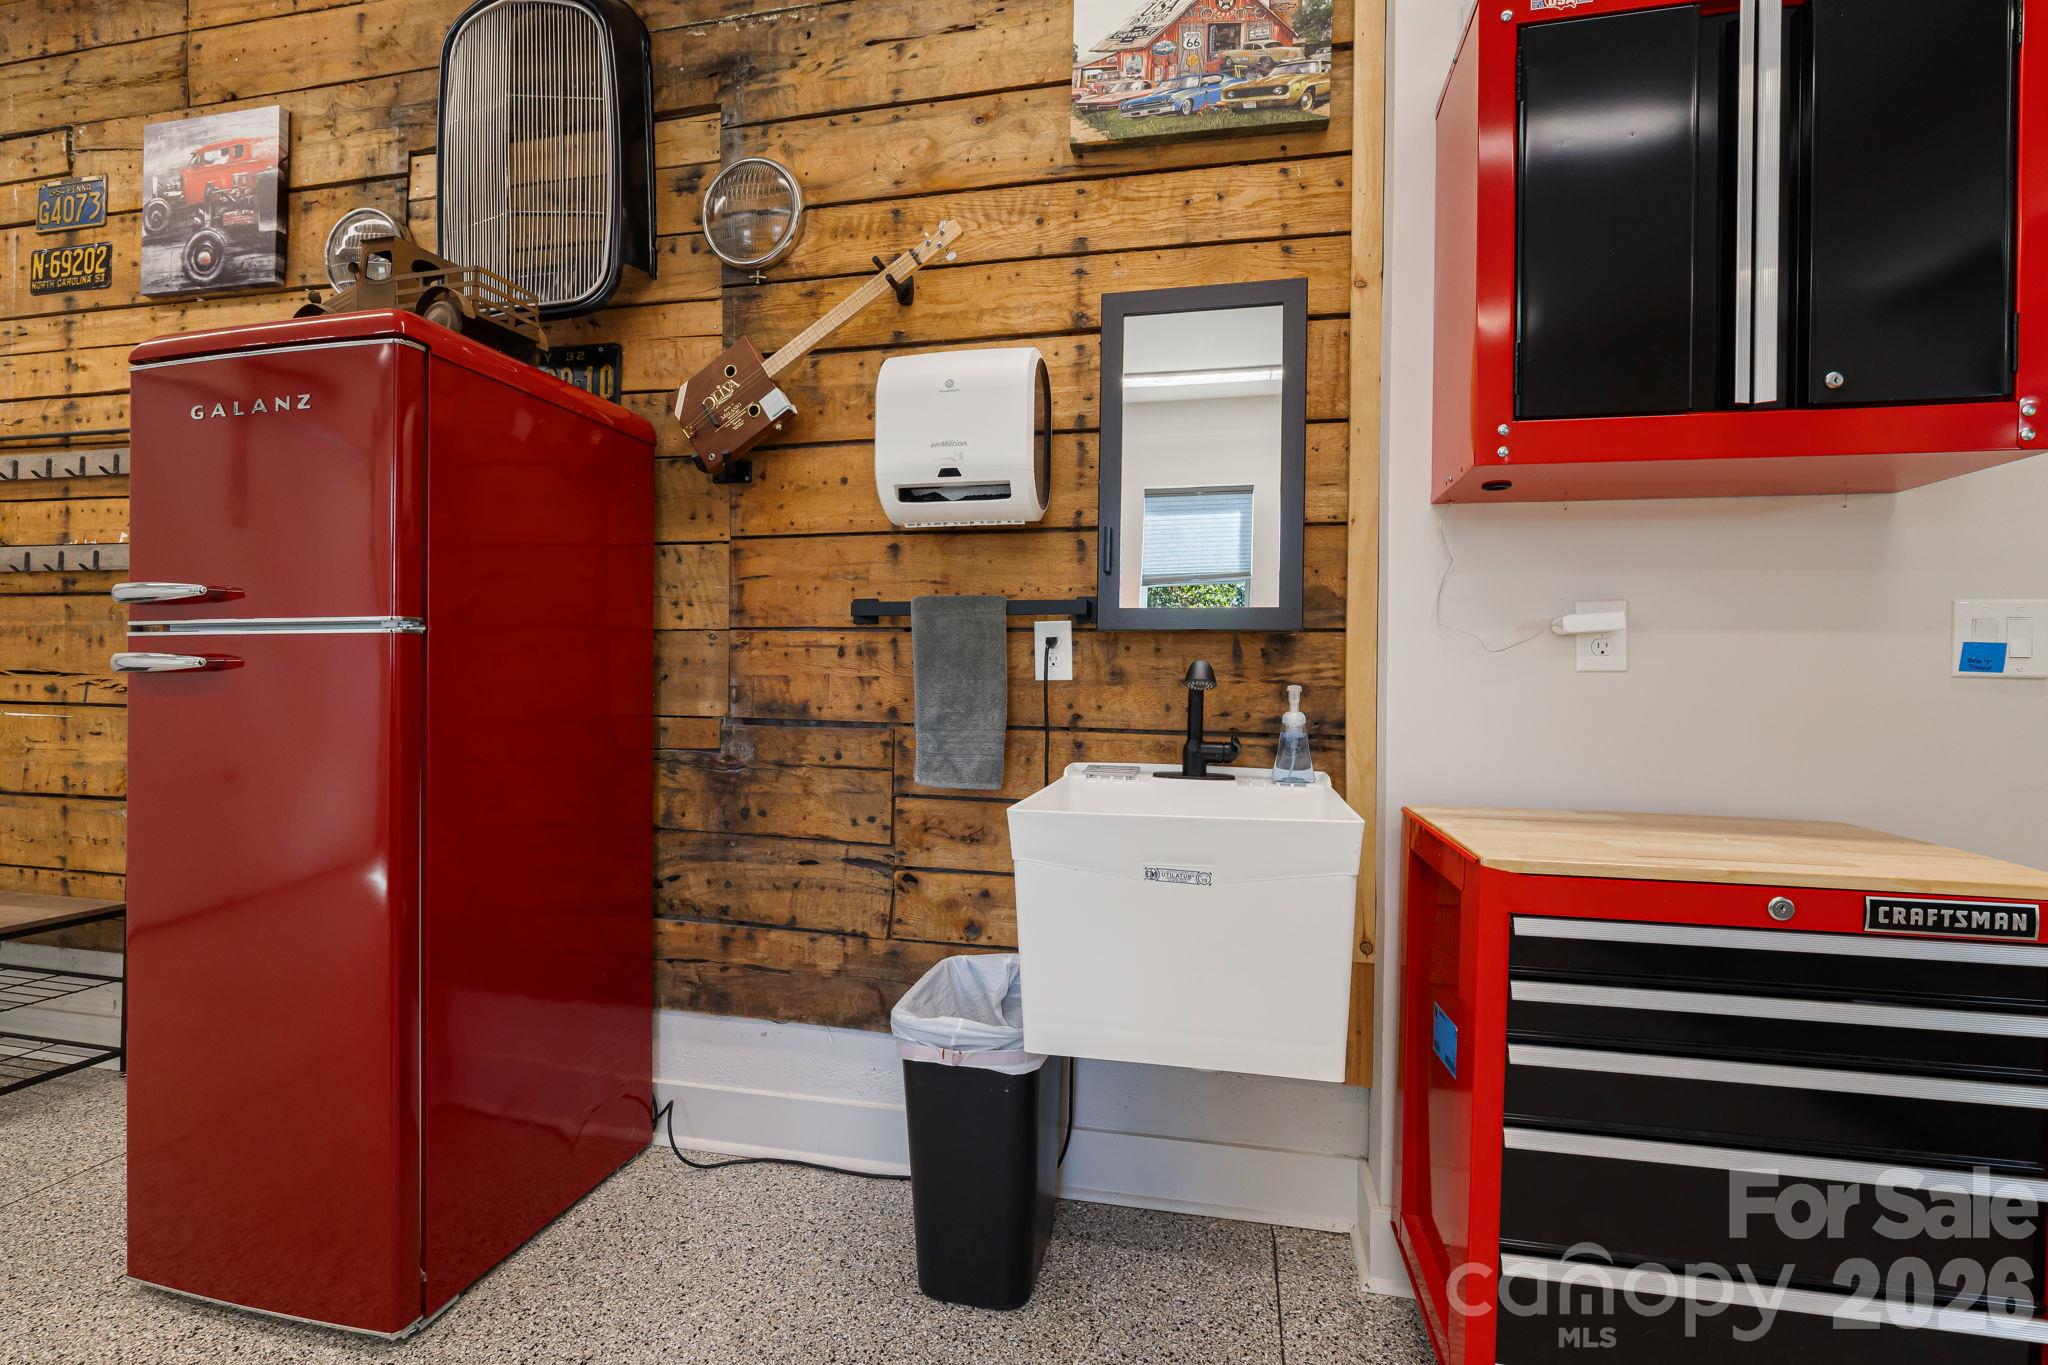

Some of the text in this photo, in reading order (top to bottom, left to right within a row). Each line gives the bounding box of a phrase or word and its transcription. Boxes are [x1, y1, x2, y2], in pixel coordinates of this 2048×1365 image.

[1186, 38, 1200, 47] 66
[40, 191, 101, 225] G4073
[33, 246, 107, 280] N-69202
[32, 279, 55, 289] NORTH
[57, 275, 91, 287] CAROLINA
[190, 393, 311, 420] GALANZ
[1877, 905, 2028, 932] CRAFTSMAN
